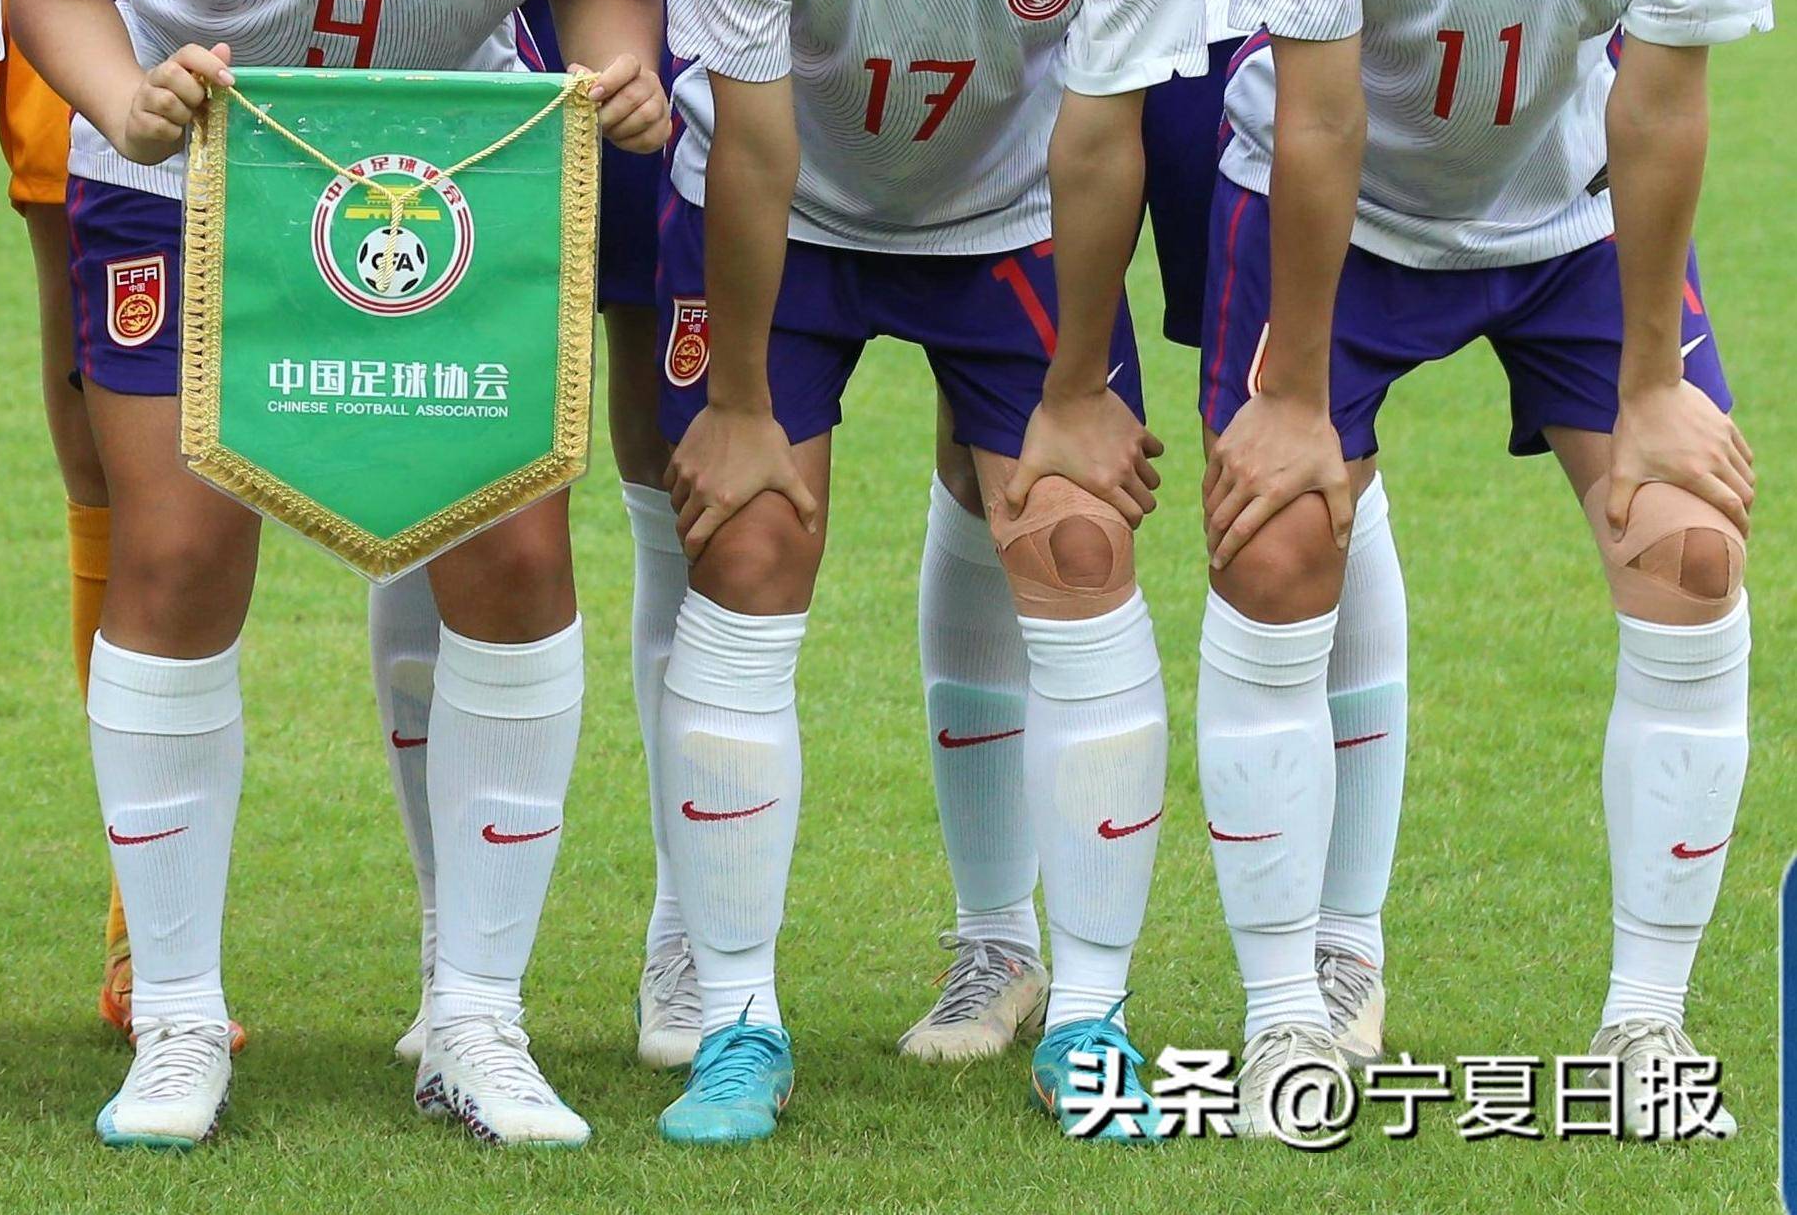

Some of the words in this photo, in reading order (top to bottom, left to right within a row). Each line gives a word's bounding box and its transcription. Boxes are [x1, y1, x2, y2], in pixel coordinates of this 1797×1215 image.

[1436, 22, 1523, 126] 11
[863, 58, 977, 142] 17
[116, 265, 158, 286] CFA
[268, 358, 510, 400] 中国足球协会
[267, 400, 328, 414] CHINESE
[335, 402, 410, 416] FOOTBALL
[415, 404, 509, 418] ASSOCIATION
